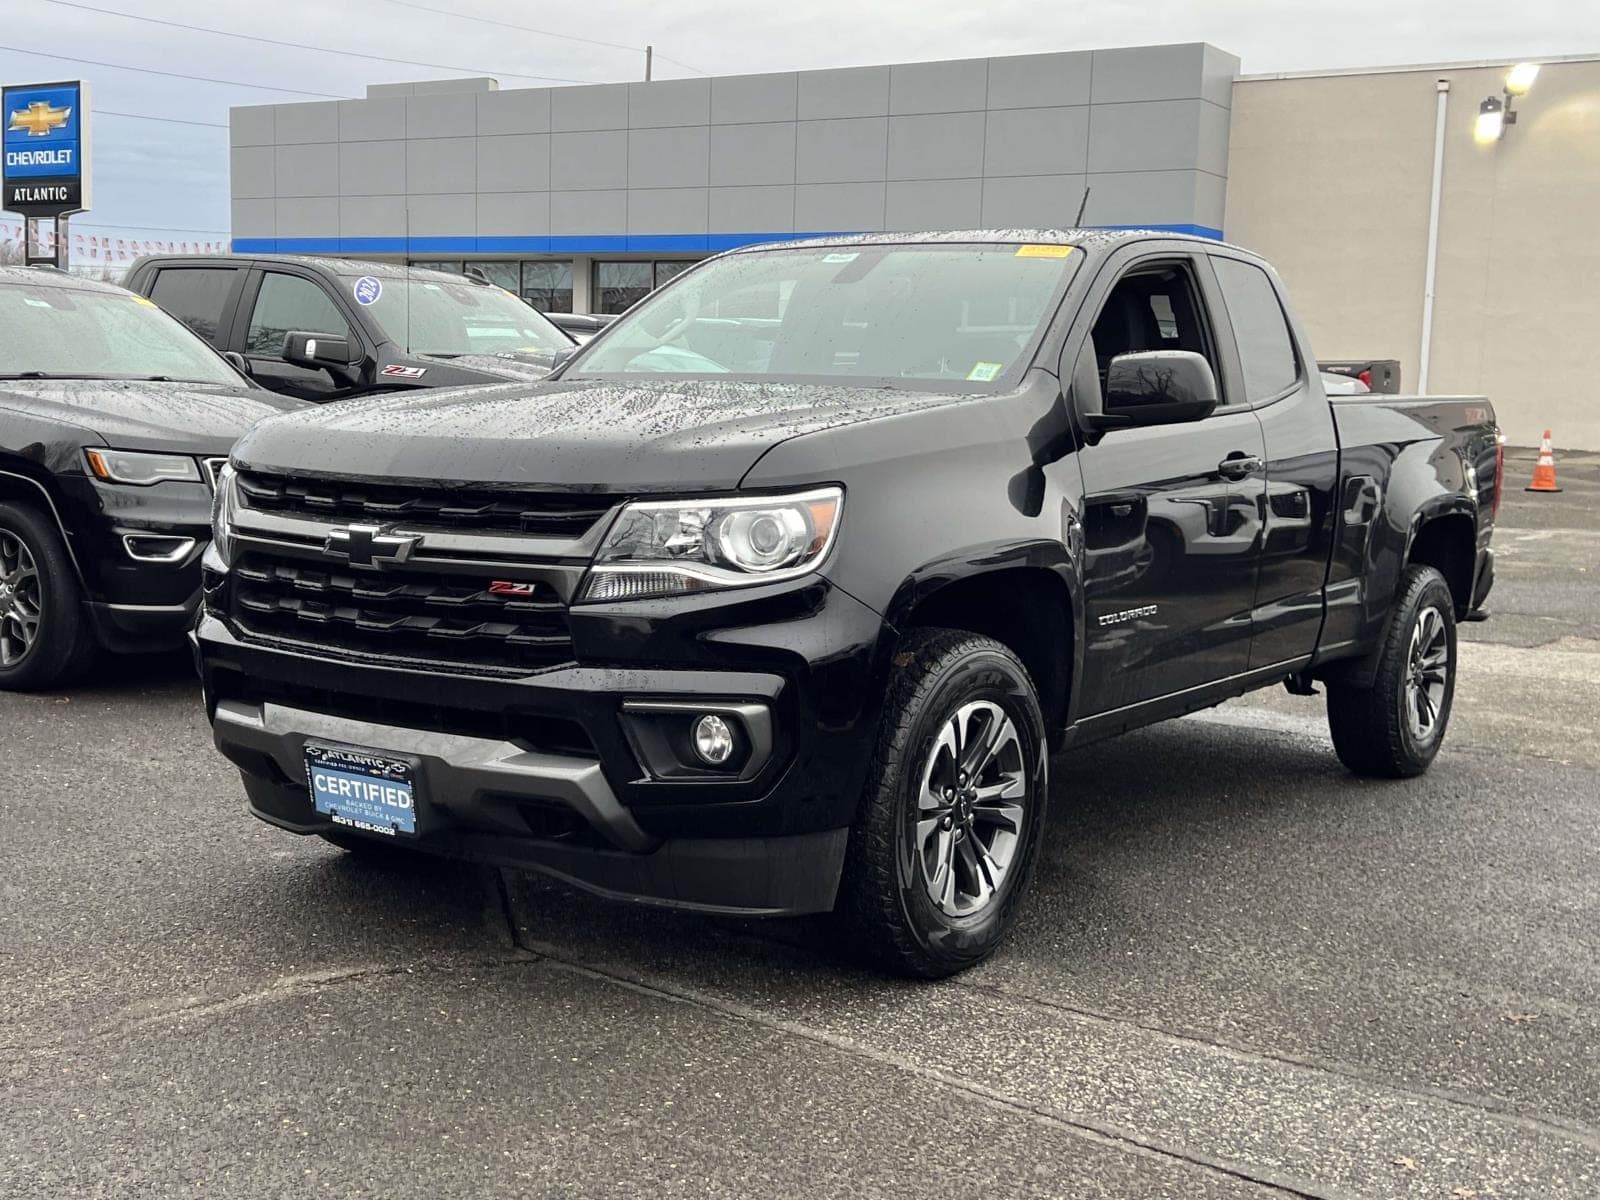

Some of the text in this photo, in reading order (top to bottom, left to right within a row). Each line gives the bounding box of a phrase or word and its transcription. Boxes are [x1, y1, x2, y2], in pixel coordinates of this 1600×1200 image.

[7, 149, 72, 166] CHEVROLET
[14, 186, 68, 201] ATLANTIC
[488, 580, 536, 596] Z71
[1098, 604, 1158, 626] COLORADO
[327, 750, 386, 769] ATLANTIC
[315, 774, 410, 809] CERTIFIED
[345, 799, 383, 812] BACKED BY
[364, 809, 384, 820] BUICK
